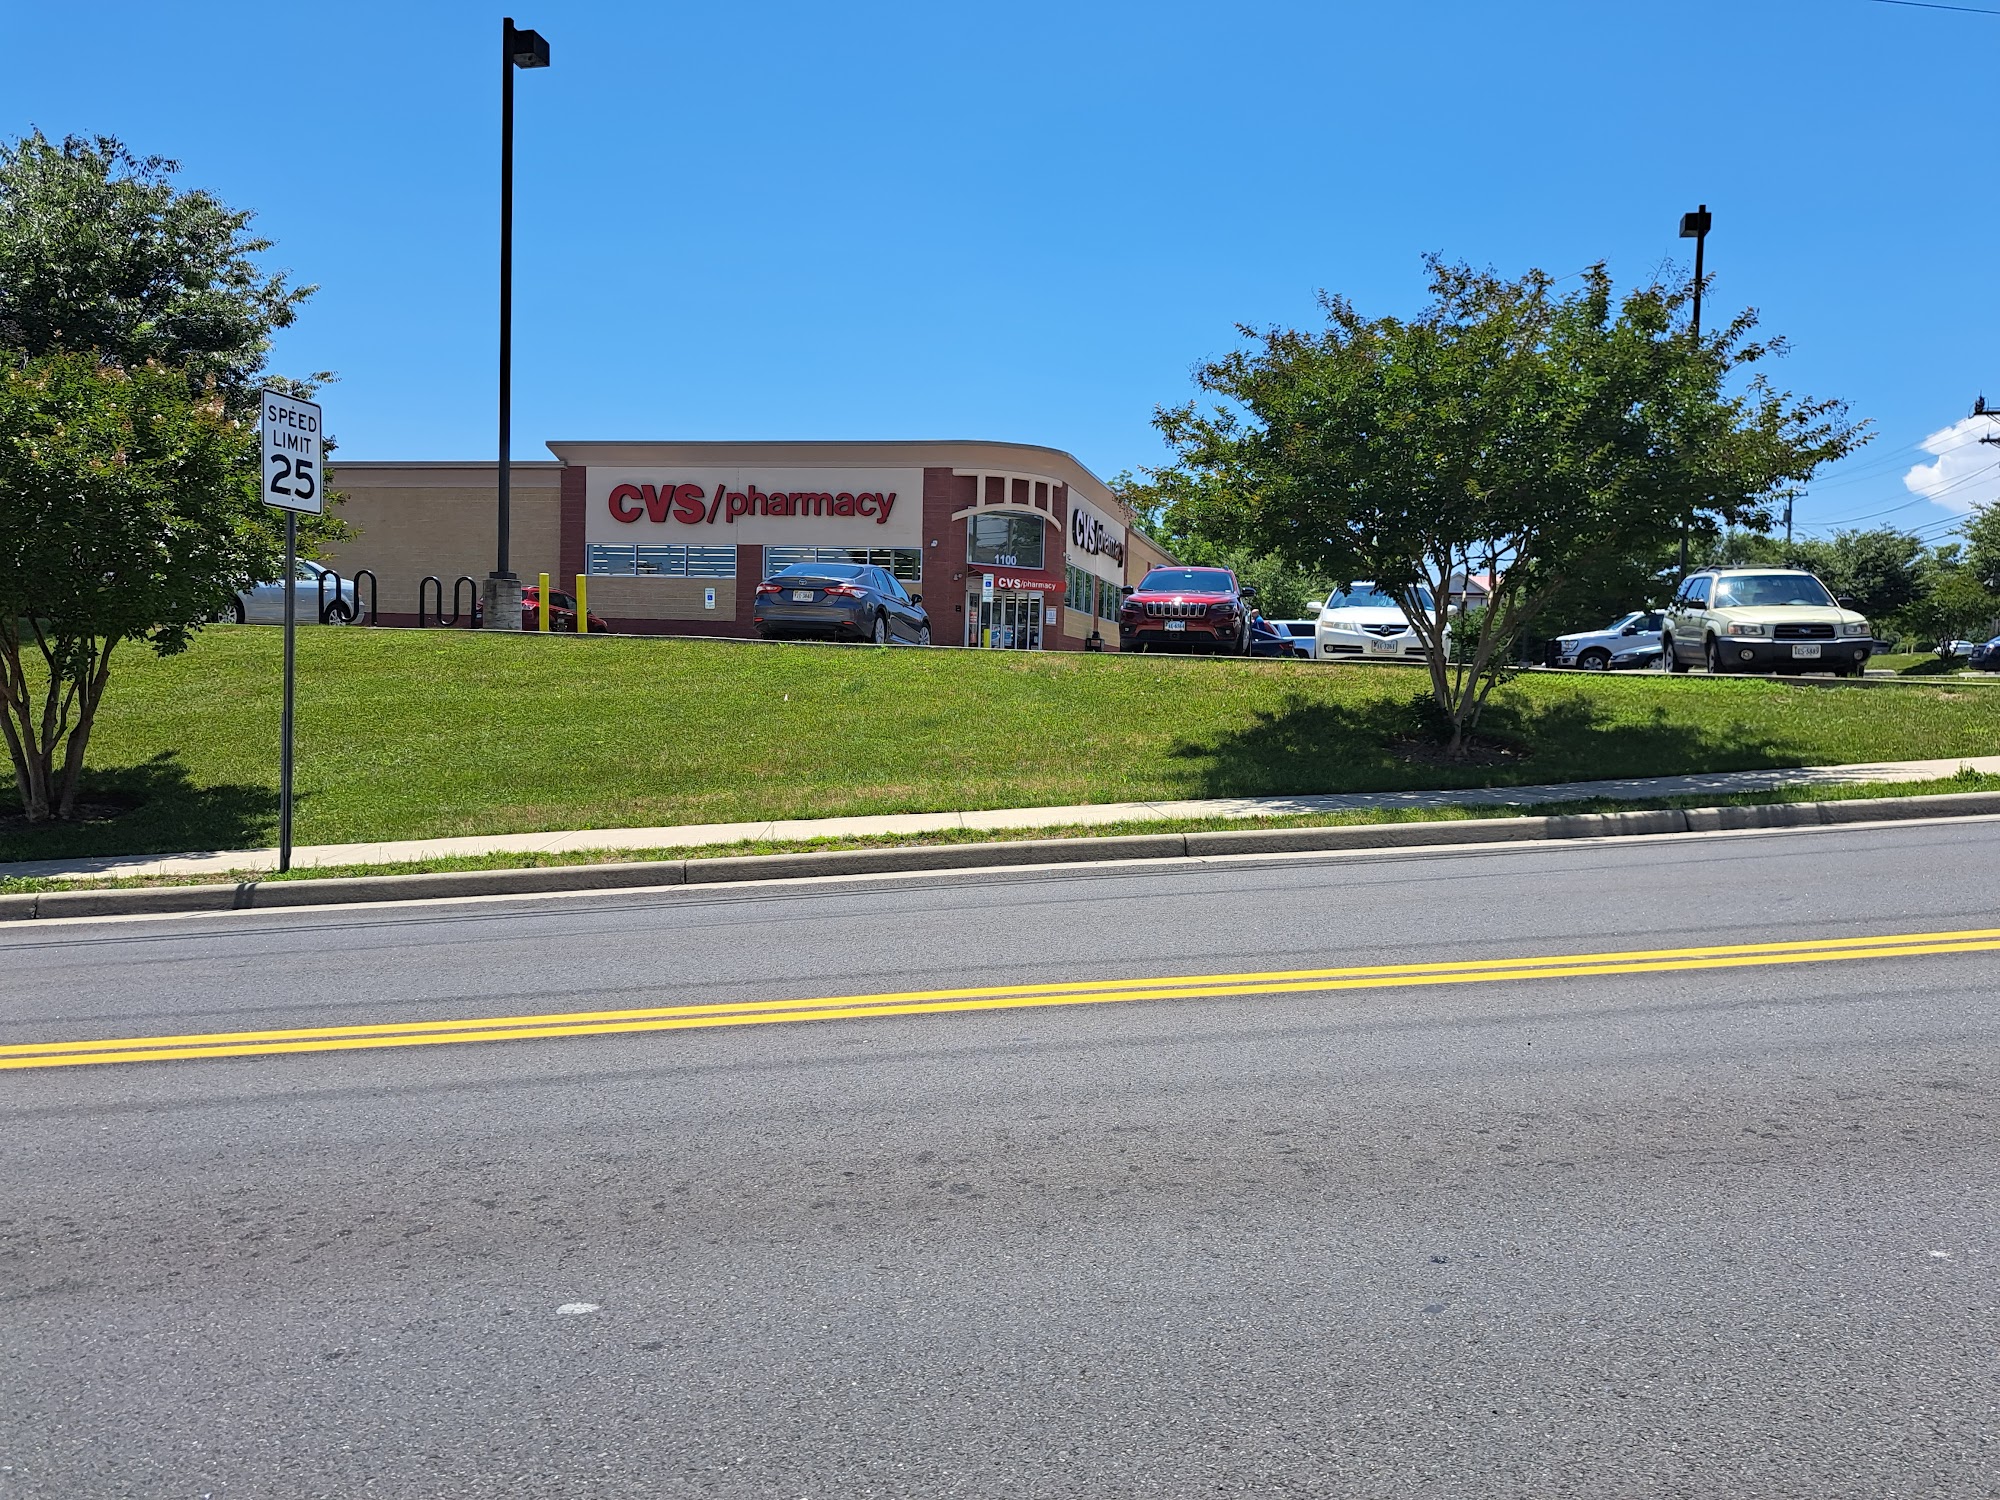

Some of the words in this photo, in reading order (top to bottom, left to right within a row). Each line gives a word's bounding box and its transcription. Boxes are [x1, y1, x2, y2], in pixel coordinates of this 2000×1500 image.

[268, 405, 317, 432] SPEED
[273, 429, 311, 454] LIMIT
[270, 453, 315, 499] 25
[608, 483, 897, 524] CVS/pharmacy
[994, 554, 1017, 565] 1100
[998, 577, 1056, 591] CVS/pharmacy
